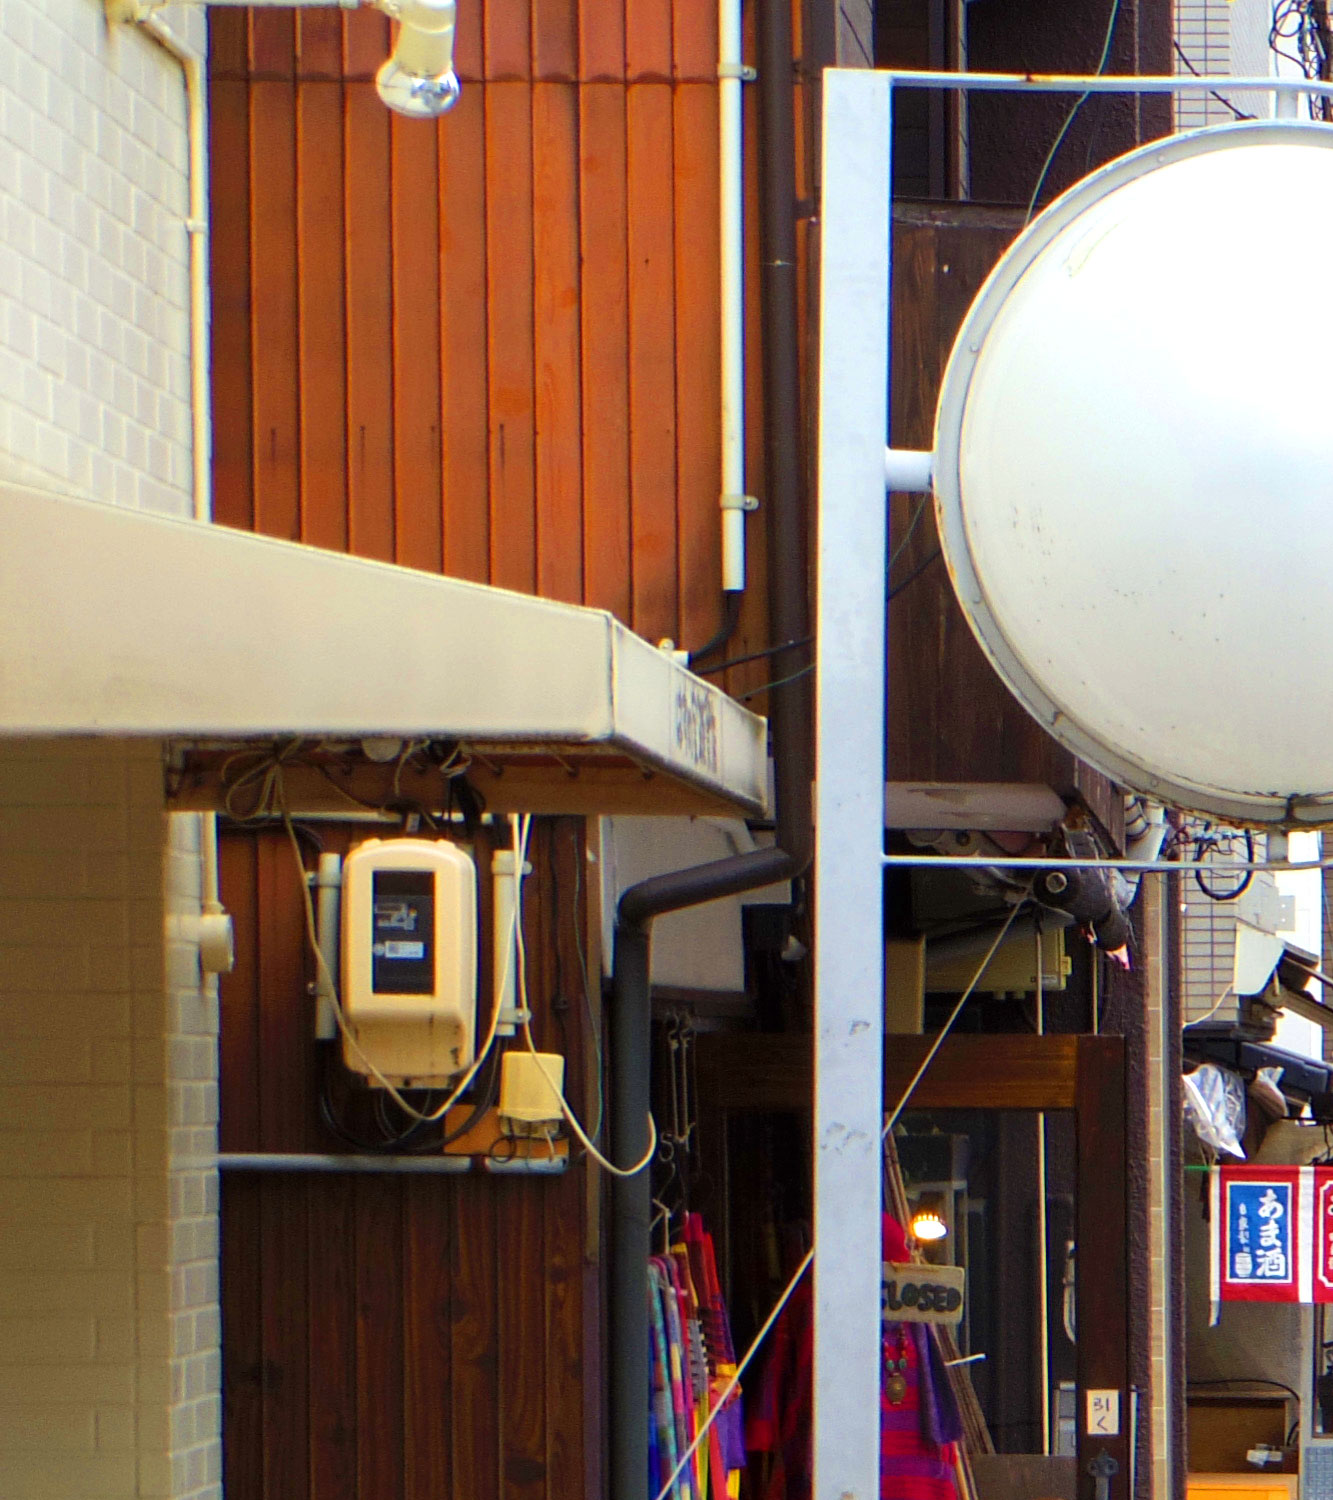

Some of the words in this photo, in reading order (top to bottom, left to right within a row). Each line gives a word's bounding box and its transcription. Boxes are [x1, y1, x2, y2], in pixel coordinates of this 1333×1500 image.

[1256, 1188, 1285, 1278] あま酒
[882, 1281, 961, 1312] LOSED
